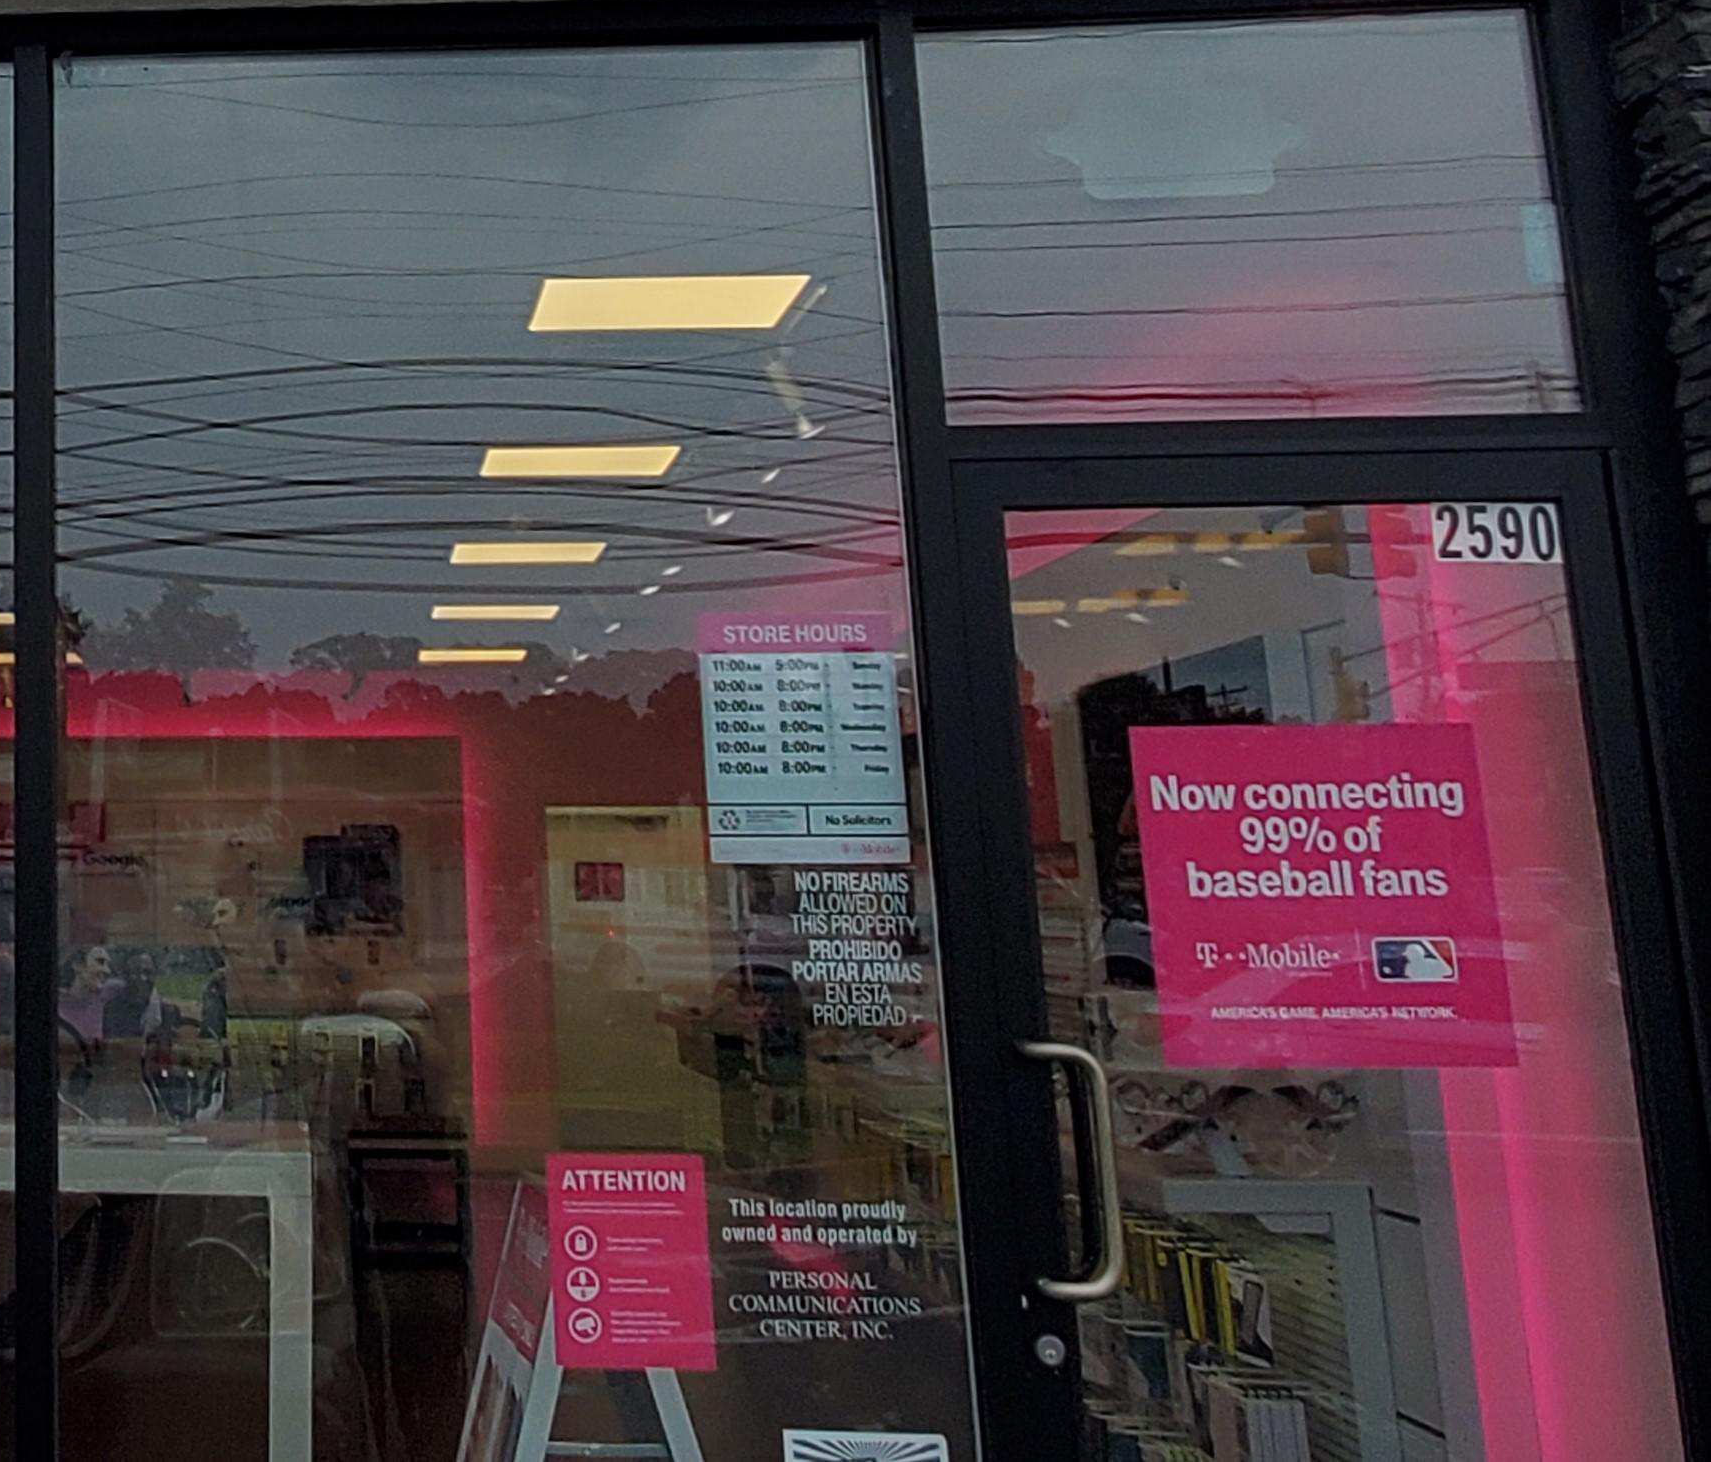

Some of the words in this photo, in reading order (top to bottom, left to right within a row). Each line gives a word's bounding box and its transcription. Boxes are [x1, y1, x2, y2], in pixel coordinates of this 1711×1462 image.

[1435, 504, 1556, 561] 2590
[723, 625, 790, 644] STORE
[795, 624, 868, 643] HOURS
[1149, 774, 1236, 811] Now
[1243, 772, 1465, 817] connecting
[825, 815, 840, 826] No
[841, 814, 893, 827] Solicitors
[1239, 815, 1337, 854] 99%
[1343, 814, 1383, 853] of
[793, 870, 820, 892] NO
[822, 870, 909, 893] FIREARMS
[1185, 859, 1355, 898] baseball
[1359, 859, 1449, 897] fans
[799, 892, 878, 914] ALLOWED
[881, 893, 907, 914] ON
[790, 913, 828, 935] THIS
[830, 914, 918, 937] PROPERTY
[808, 939, 902, 961] PROHIBIDO
[791, 960, 860, 982] PORTAR
[861, 961, 923, 984] ARMAS
[825, 982, 848, 1004] EN
[851, 983, 892, 1005] ESTA
[812, 1003, 907, 1027] PROPIEDAD
[561, 1169, 686, 1193] ATTENTION
[728, 1197, 765, 1218] This
[769, 1198, 838, 1219] location
[842, 1199, 906, 1223] proudly
[721, 1224, 777, 1243] owned
[780, 1225, 812, 1243] and
[817, 1225, 893, 1248] operated
[896, 1225, 918, 1248] by
[768, 1270, 878, 1291] PERSONAL
[728, 1293, 922, 1316] COMMUNICATIONS
[759, 1318, 848, 1342] CENTER,
[852, 1320, 894, 1340] INC.
